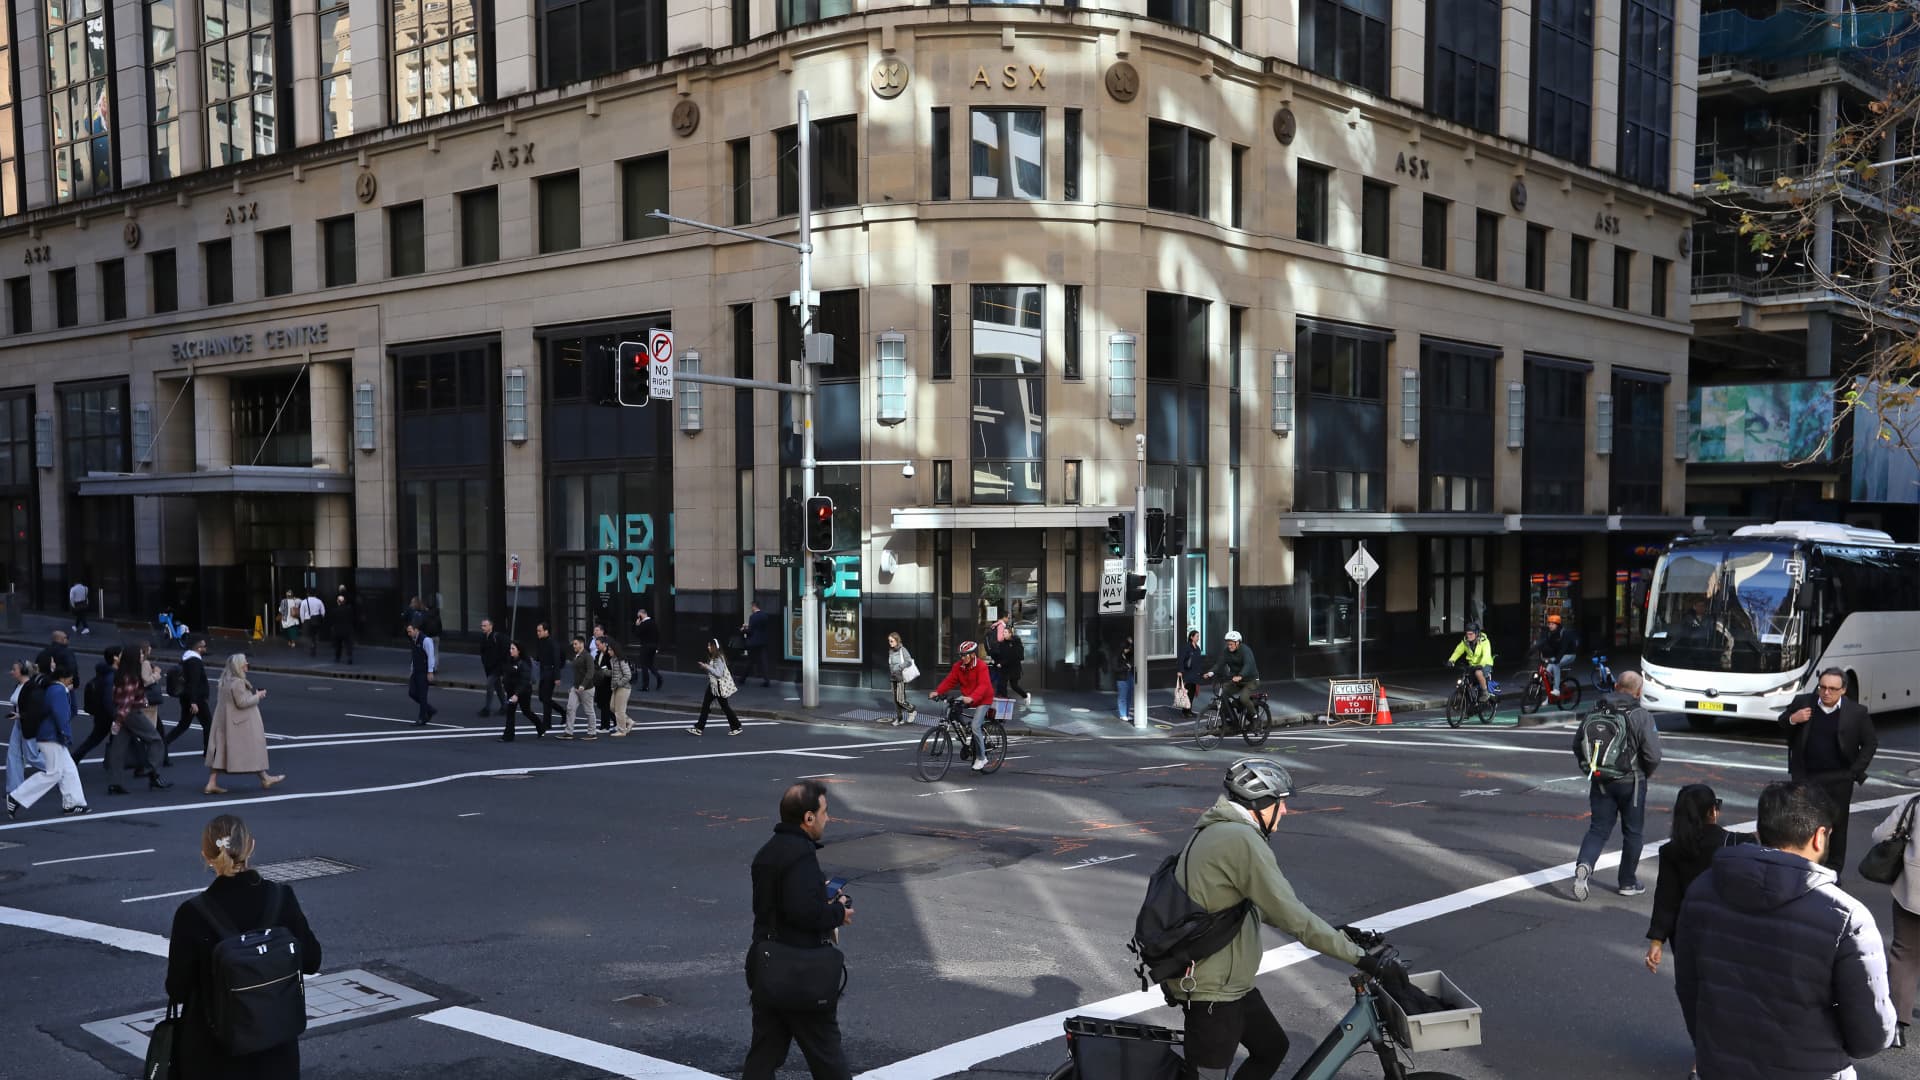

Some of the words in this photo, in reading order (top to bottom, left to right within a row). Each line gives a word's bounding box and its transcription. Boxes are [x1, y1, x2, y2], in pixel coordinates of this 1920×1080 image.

[970, 64, 1047, 90] ASX
[491, 142, 535, 170] ASX
[1395, 151, 1430, 180] ASX
[225, 202, 258, 224] ASX
[1594, 211, 1620, 235] ASX
[24, 245, 51, 264] ASX
[171, 333, 253, 362] EXCHANGE
[264, 322, 328, 350] CENTRE
[655, 365, 669, 376] NO
[652, 377, 671, 387] RIGHT
[653, 388, 671, 397] TURN
[772, 556, 788, 566] Bridge
[789, 556, 795, 565] St
[1104, 574, 1122, 585] ONE
[1102, 587, 1123, 598] WAY
[1335, 684, 1372, 694] CYCLISTS
